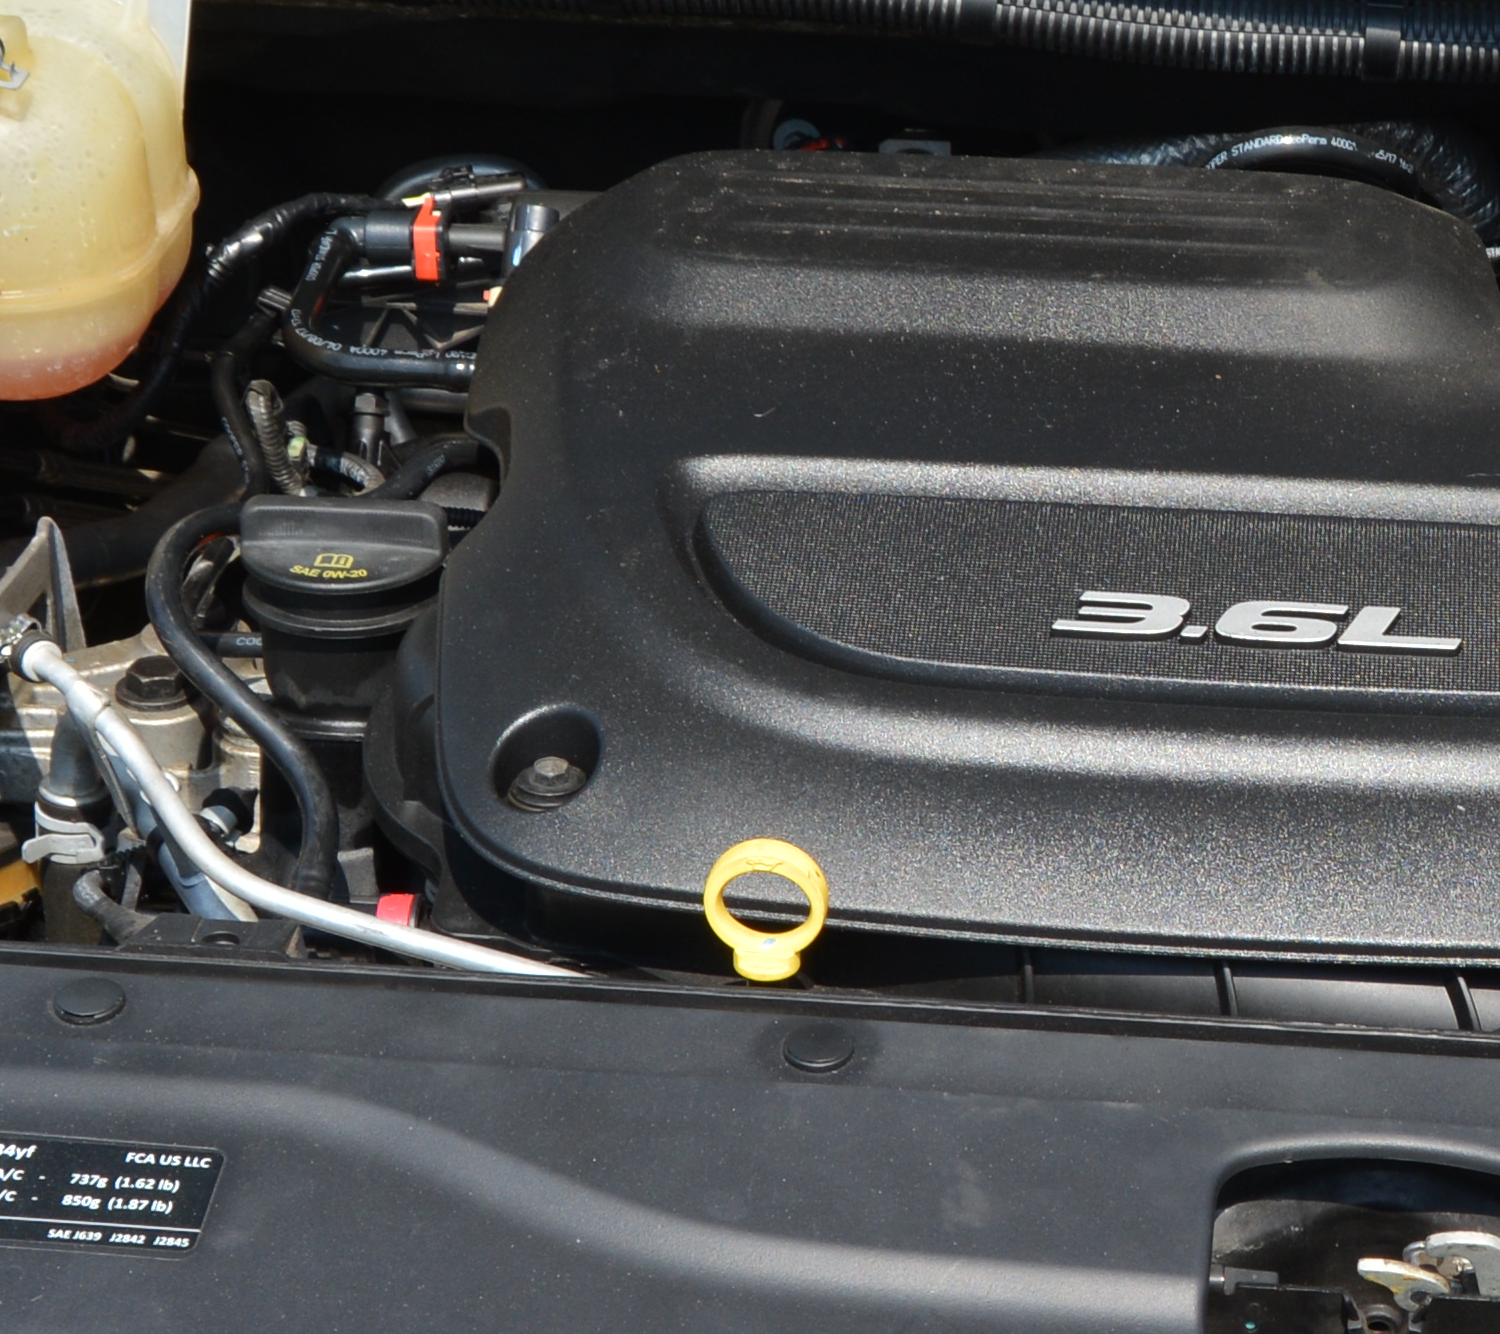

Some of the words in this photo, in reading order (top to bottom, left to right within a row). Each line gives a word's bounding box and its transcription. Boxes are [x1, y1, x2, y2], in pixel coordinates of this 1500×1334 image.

[289, 565, 321, 578] SAE
[322, 568, 368, 579] 0W-20
[1051, 590, 1463, 656] 3.6L
[125, 1151, 156, 1165] FCA
[159, 1154, 181, 1167] US
[184, 1156, 212, 1168] LLC
[69, 1173, 109, 1189] 737g
[114, 1175, 156, 1191] (1.62
[158, 1178, 180, 1194] lb)
[61, 1194, 102, 1210] 850g
[107, 1197, 149, 1211] (1.87
[151, 1199, 173, 1215] lb)
[47, 1228, 72, 1240] SAE
[72, 1230, 102, 1242] J639
[108, 1232, 146, 1245] J2842
[152, 1235, 190, 1248] J2845
